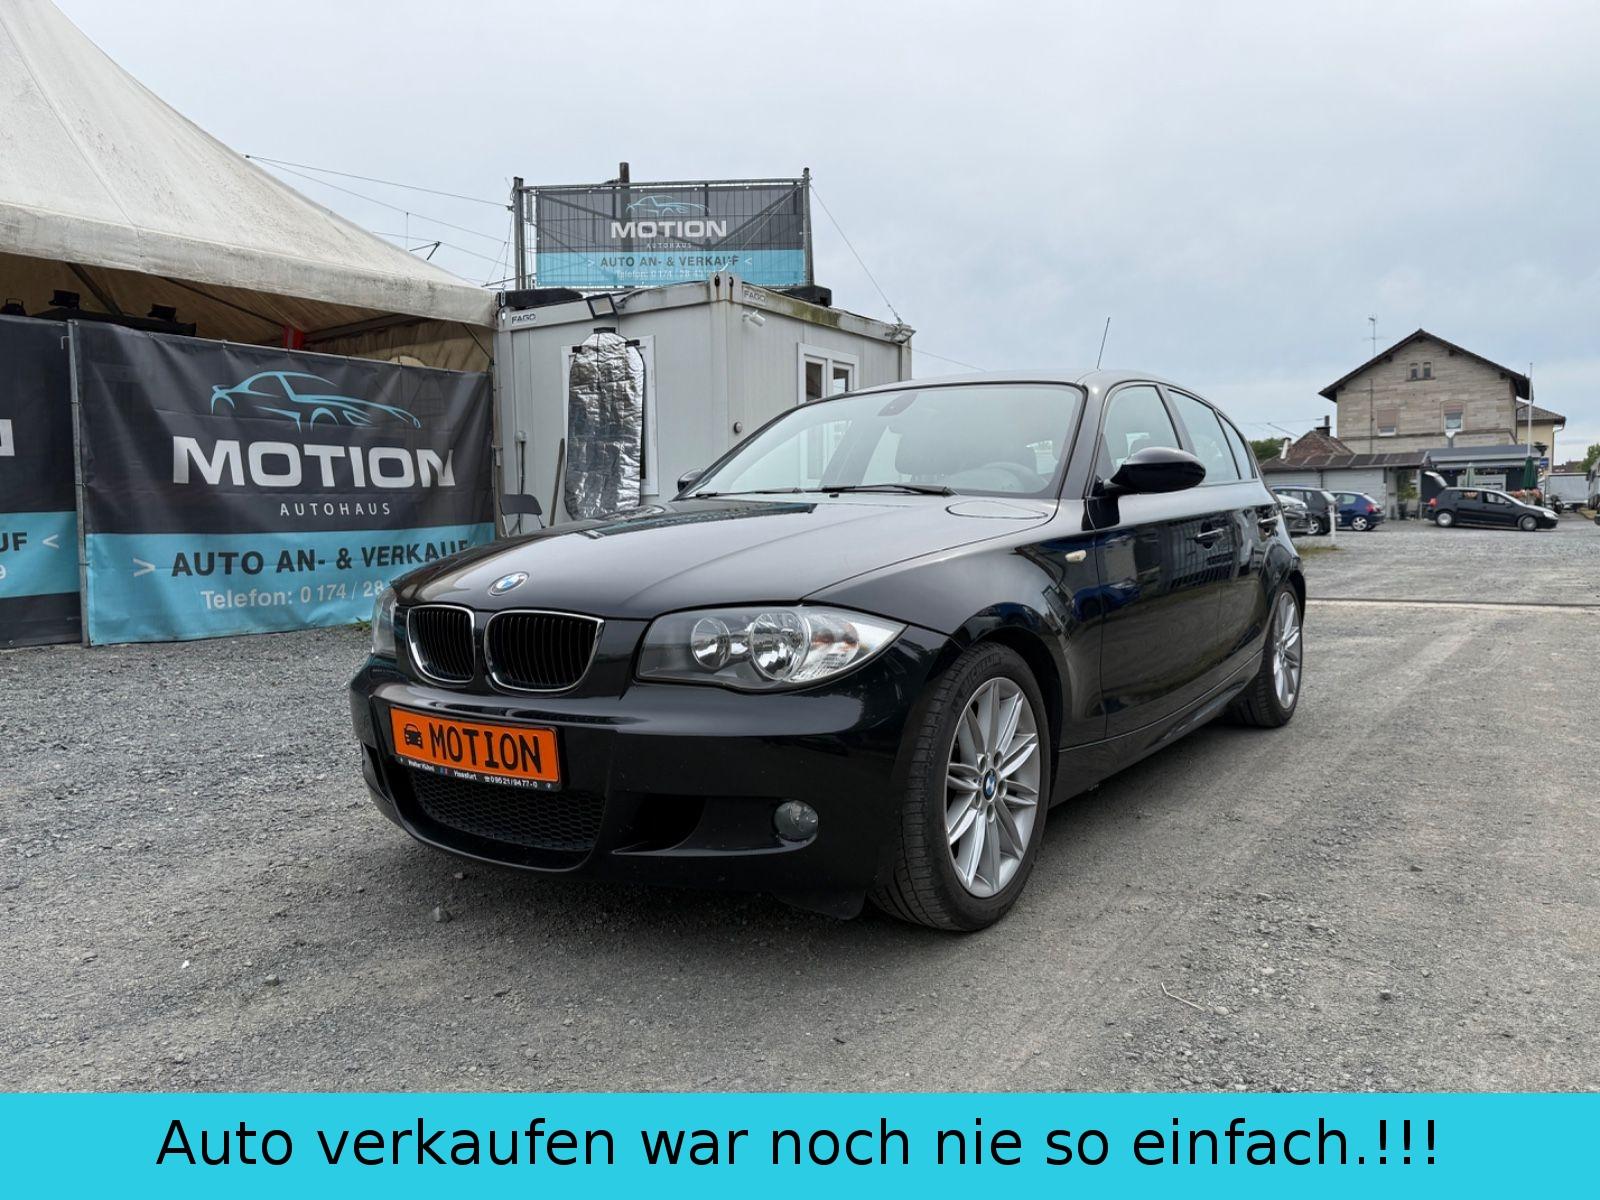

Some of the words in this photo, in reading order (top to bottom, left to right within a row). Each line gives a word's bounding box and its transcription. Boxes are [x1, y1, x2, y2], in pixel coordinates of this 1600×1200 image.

[611, 220, 727, 238] MOTION
[600, 256, 635, 267] AUTO
[640, 256, 661, 266] AN-
[667, 256, 675, 267] &
[679, 255, 739, 266] VERKAUF
[511, 313, 536, 324] FAGO
[173, 435, 456, 488] MOTION
[280, 502, 391, 516] AUTOHAUS
[171, 551, 264, 577] AUTO
[275, 549, 326, 573] AN-
[336, 548, 352, 570] &
[200, 588, 293, 609] Telefon:
[301, 586, 311, 603] 0
[317, 583, 346, 600] 174
[429, 722, 542, 774] MOTION
